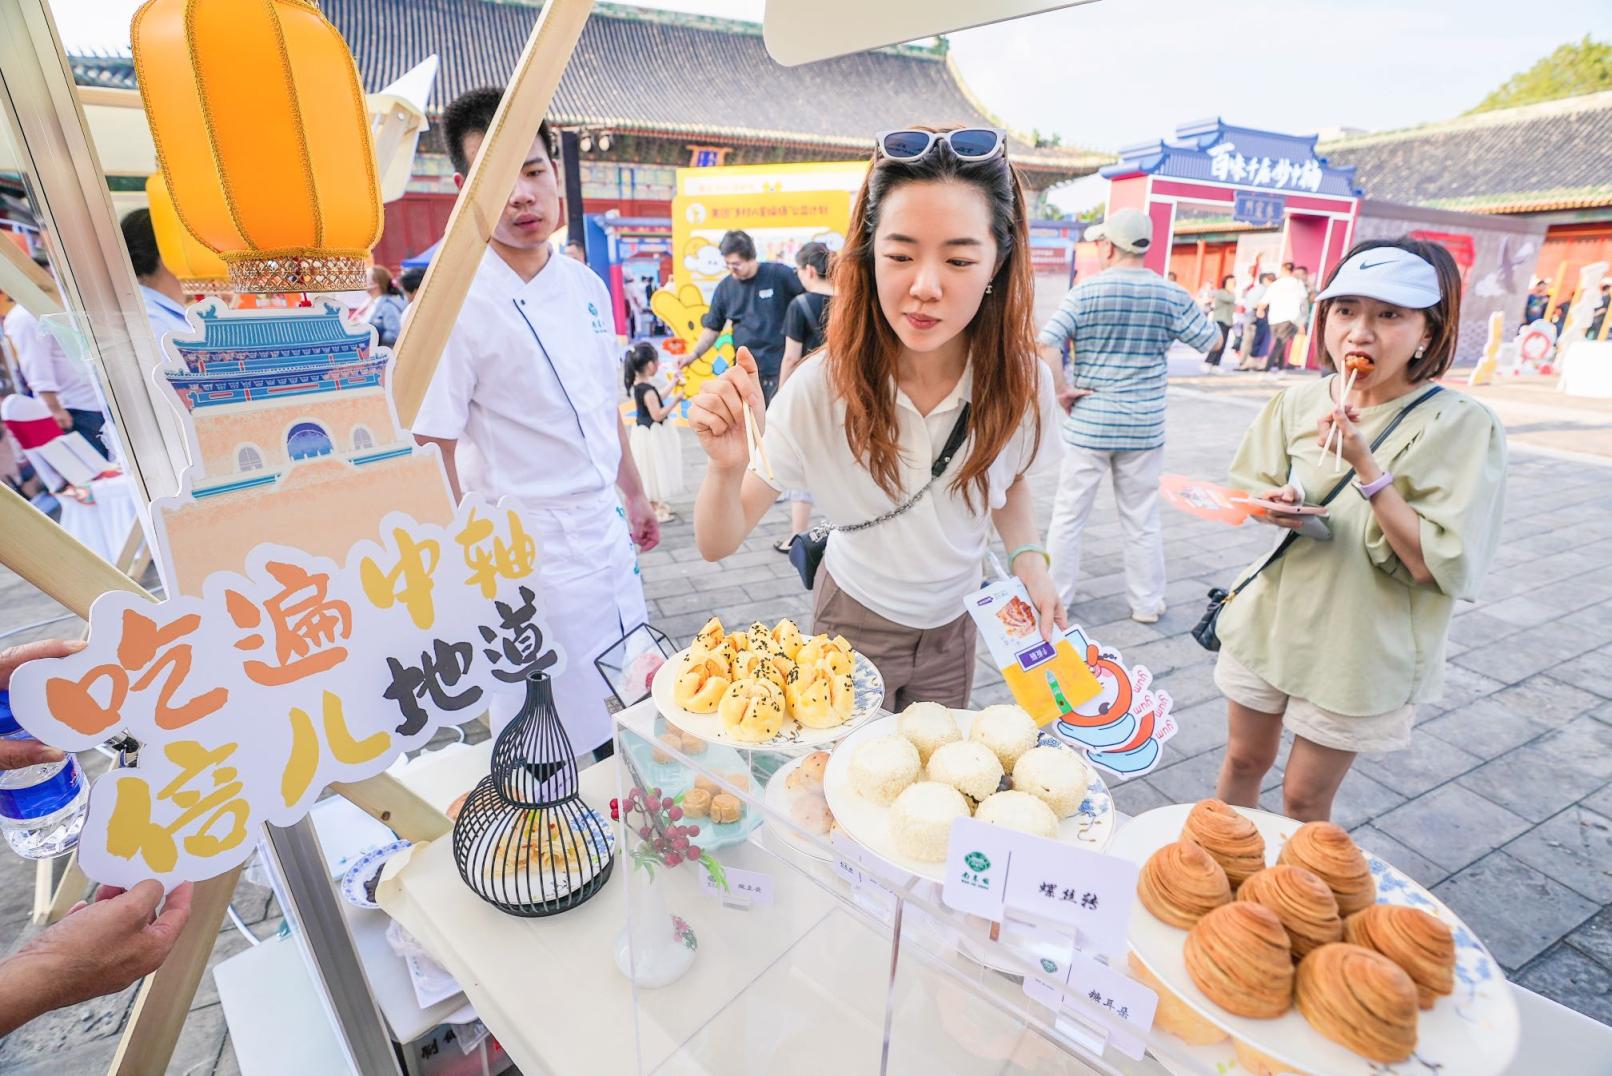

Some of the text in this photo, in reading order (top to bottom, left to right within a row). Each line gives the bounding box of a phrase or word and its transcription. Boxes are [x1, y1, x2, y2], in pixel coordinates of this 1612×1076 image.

[46, 506, 536, 735] 吃遍中轴
[107, 586, 557, 873] 倍儿地道
[1038, 881, 1099, 910] 螺丝转
[1088, 989, 1129, 1019] 糖耳朵
